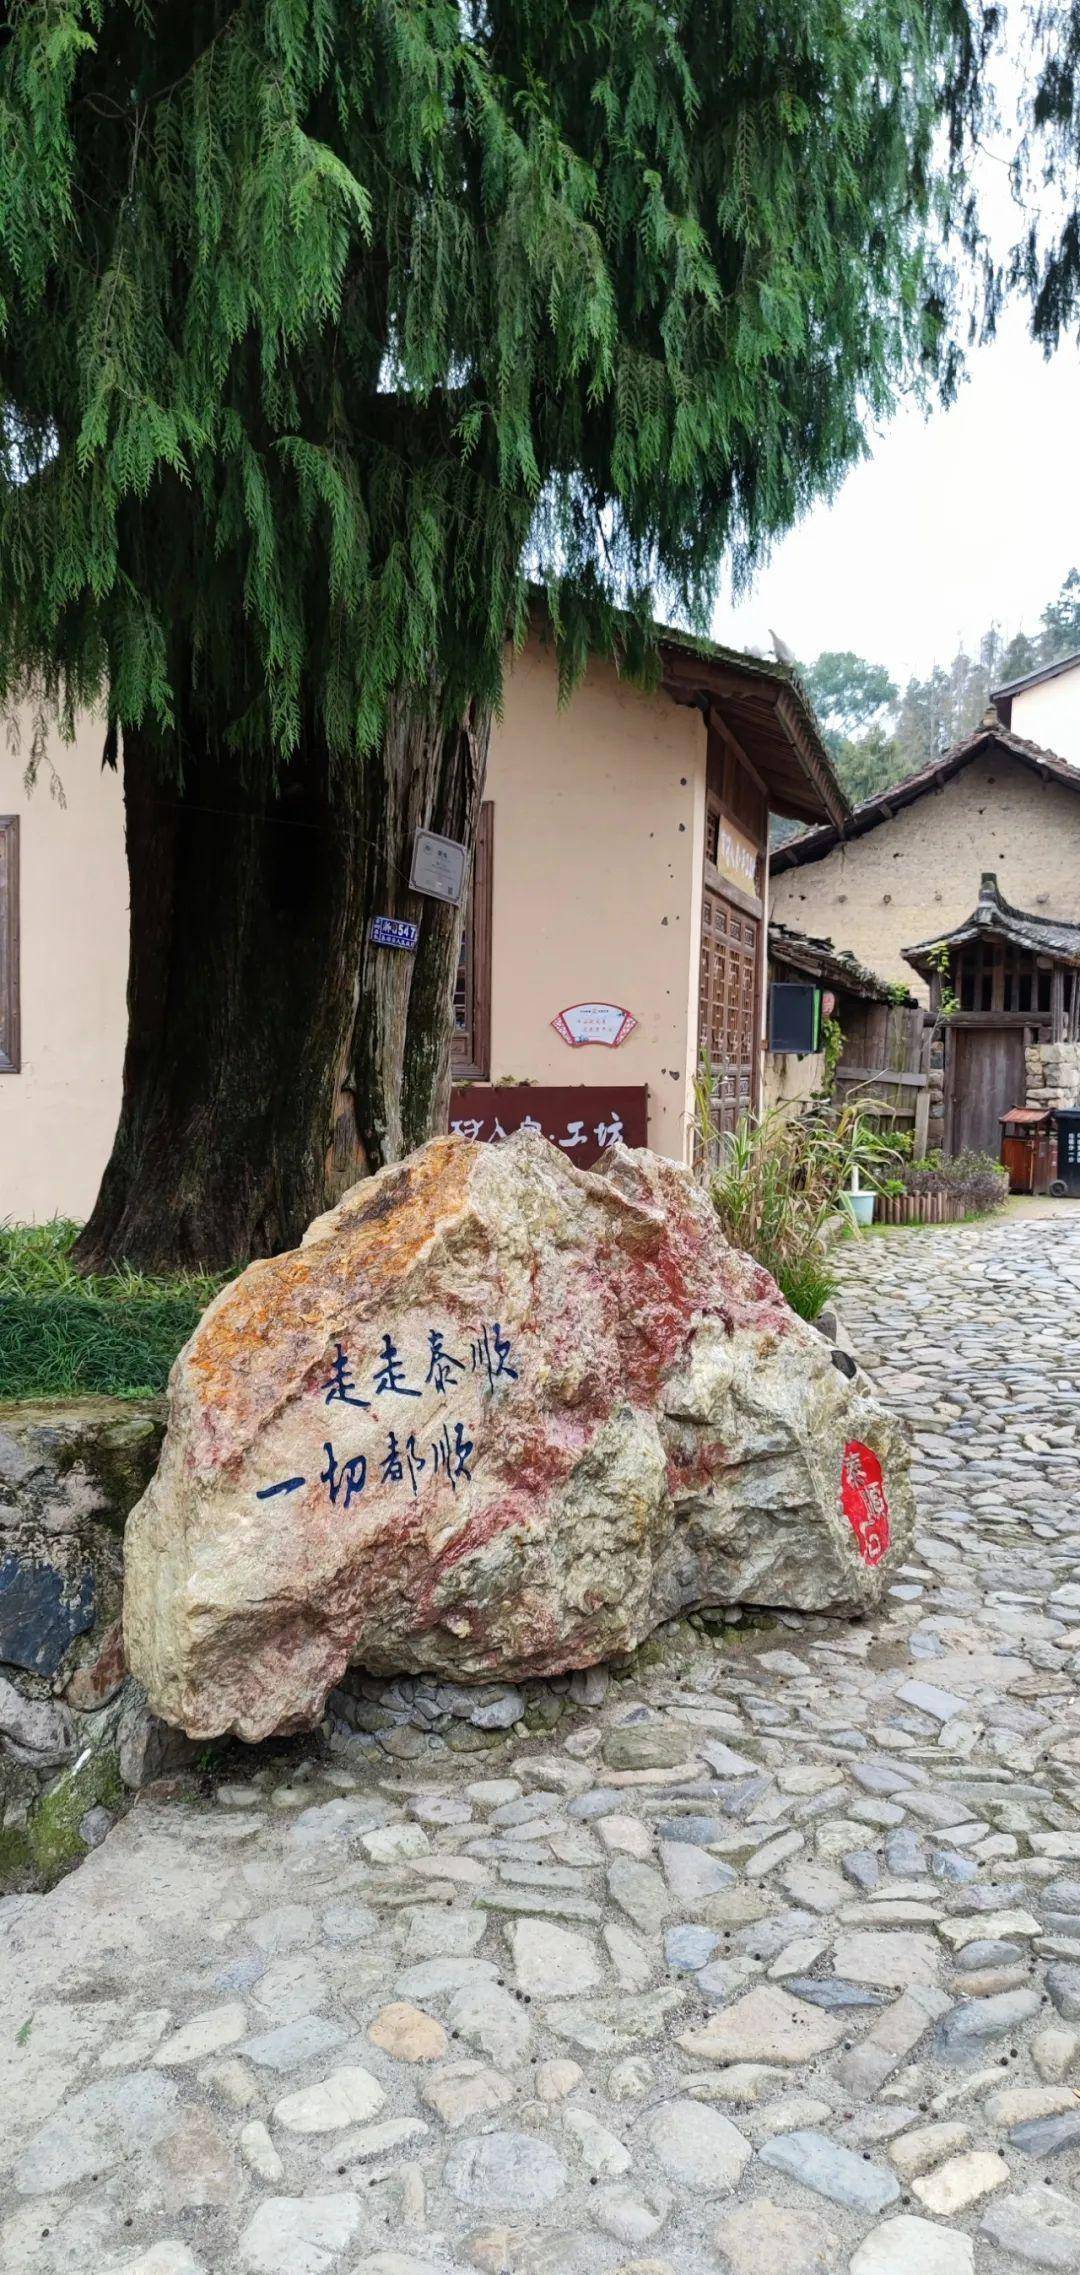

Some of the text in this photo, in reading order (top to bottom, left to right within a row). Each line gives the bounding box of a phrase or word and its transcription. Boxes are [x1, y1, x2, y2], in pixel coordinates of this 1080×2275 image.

[321, 1322, 519, 1407] 走走泰顺
[256, 1422, 474, 1509] 一切都顺
